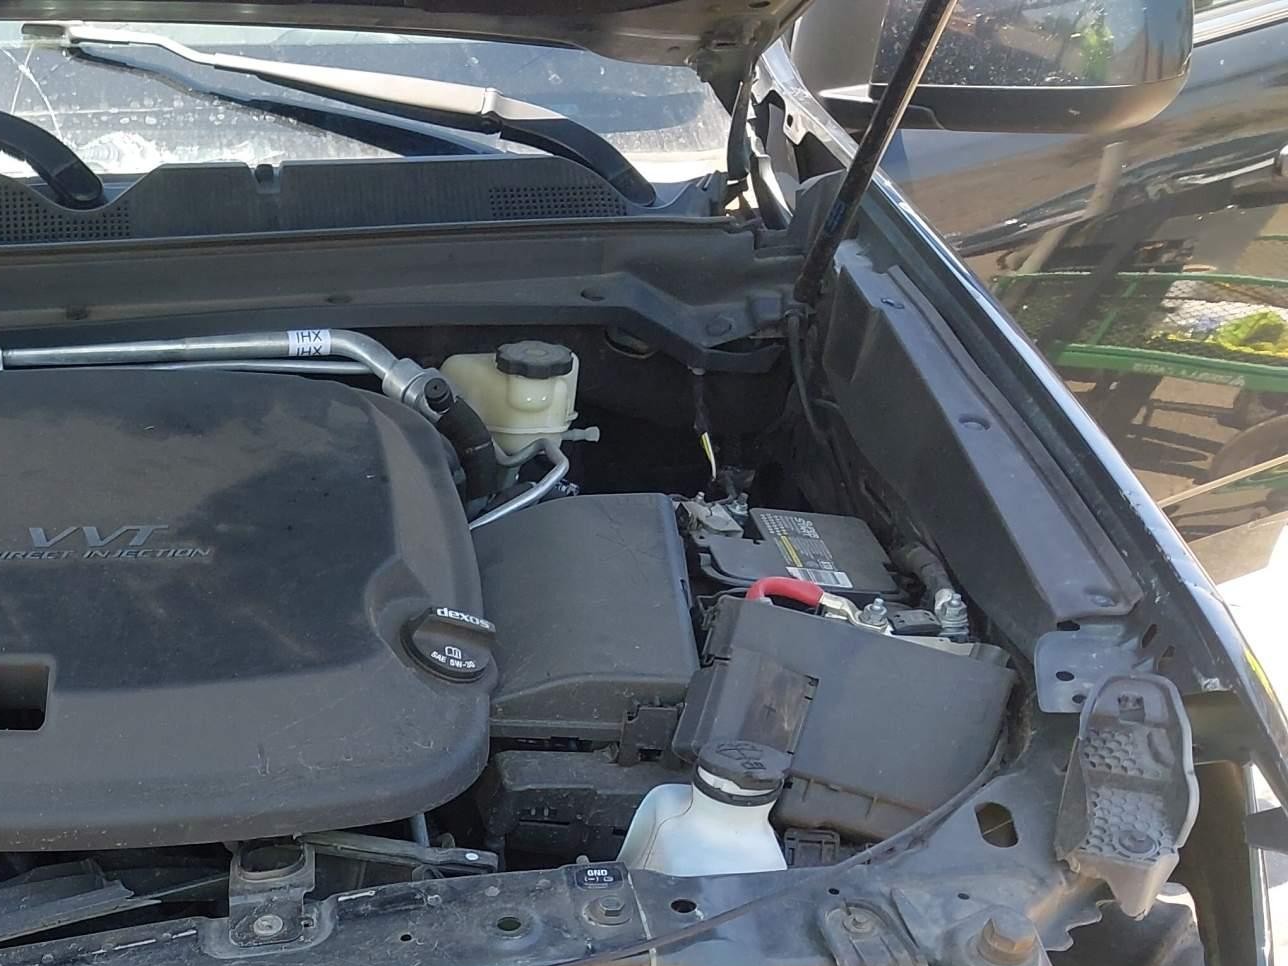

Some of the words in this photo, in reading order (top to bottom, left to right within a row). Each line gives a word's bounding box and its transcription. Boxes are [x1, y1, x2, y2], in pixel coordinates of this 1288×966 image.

[28, 524, 169, 548] VVT
[82, 547, 213, 560] INJECTION
[436, 607, 491, 629] dexos
